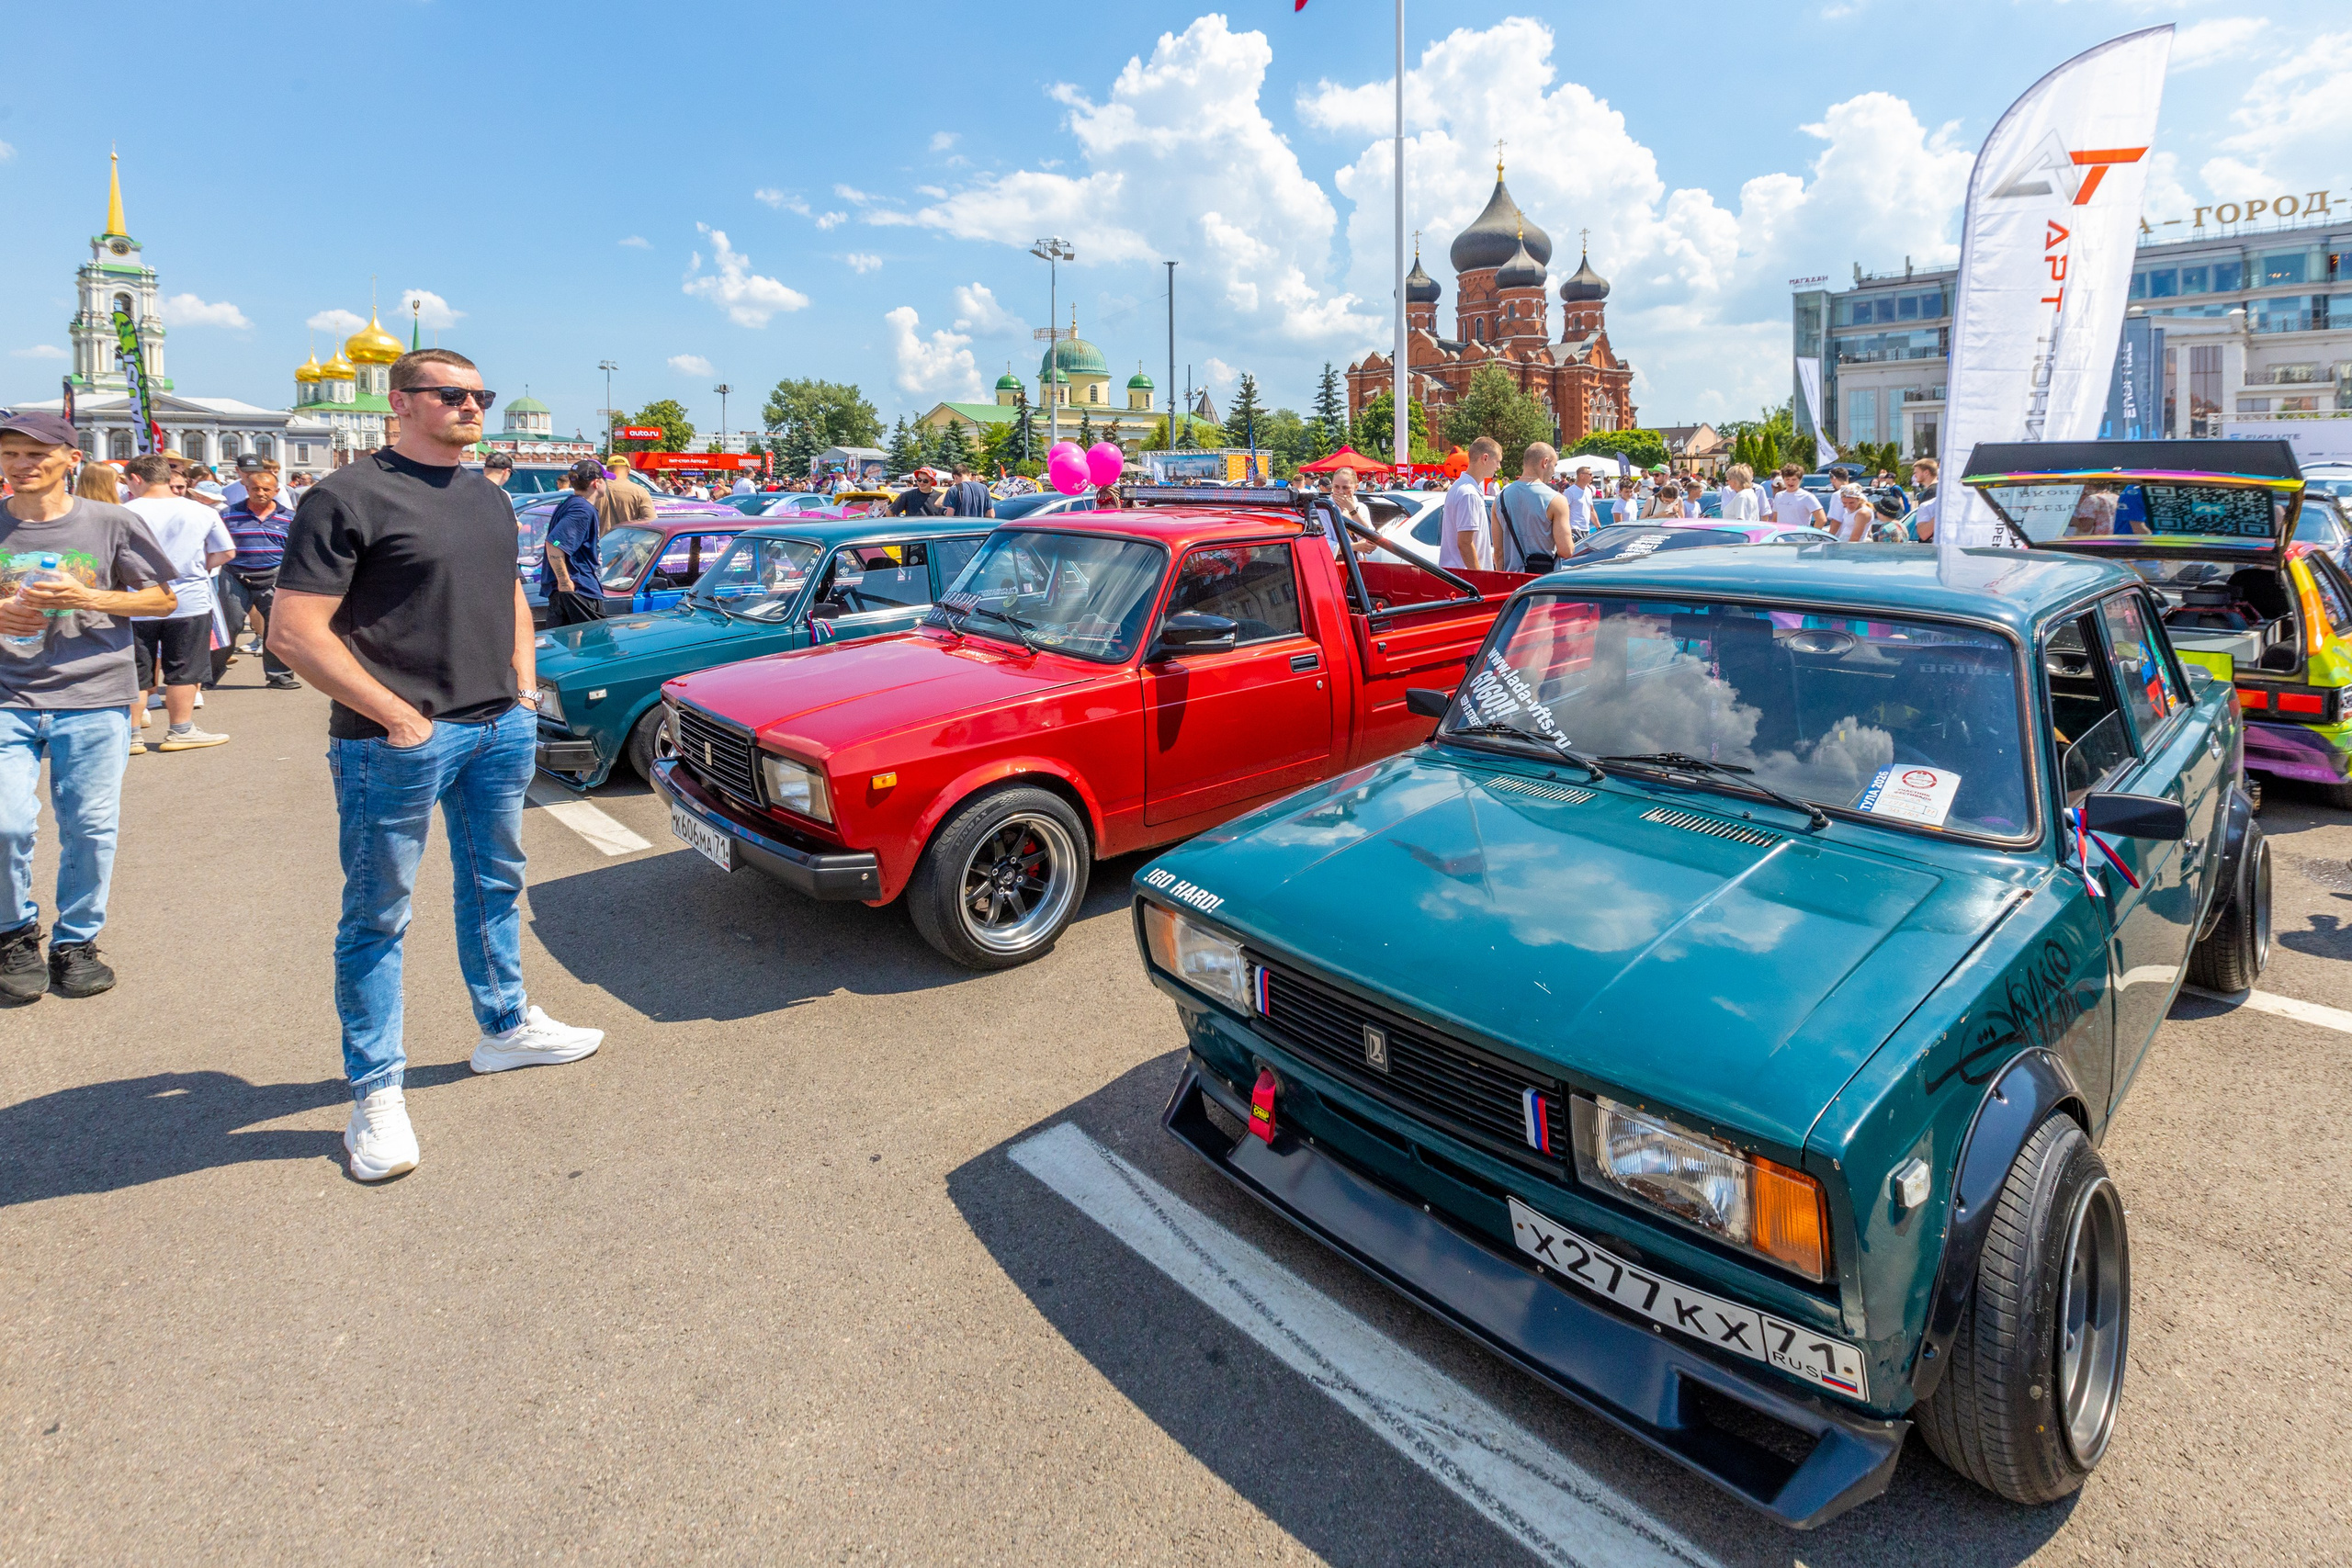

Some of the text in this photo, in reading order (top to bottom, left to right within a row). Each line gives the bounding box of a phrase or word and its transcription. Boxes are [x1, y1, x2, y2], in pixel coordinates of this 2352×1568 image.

[1789, 276, 1828, 285] МАГАДАН
[2040, 219, 2070, 312] АРТ
[1919, 663, 2001, 676] BRIDE
[1463, 703, 1473, 712] IT
[1469, 670, 1521, 720] GOGO!!
[1487, 647, 1572, 750] www.lada-vfts.ru
[1860, 771, 1889, 812] ТУЛА 2026
[1894, 791, 1932, 801] ФЕСТИВАЛЯ
[1897, 787, 1930, 797] УЧАСТНИК
[675, 814, 726, 859] К606МА 71
[1169, 880, 1225, 913] HARD!
[1253, 1107, 1270, 1119] OMP
[1530, 1224, 1836, 1374] Х277КХ 71
[1772, 1350, 1820, 1380] RUS
